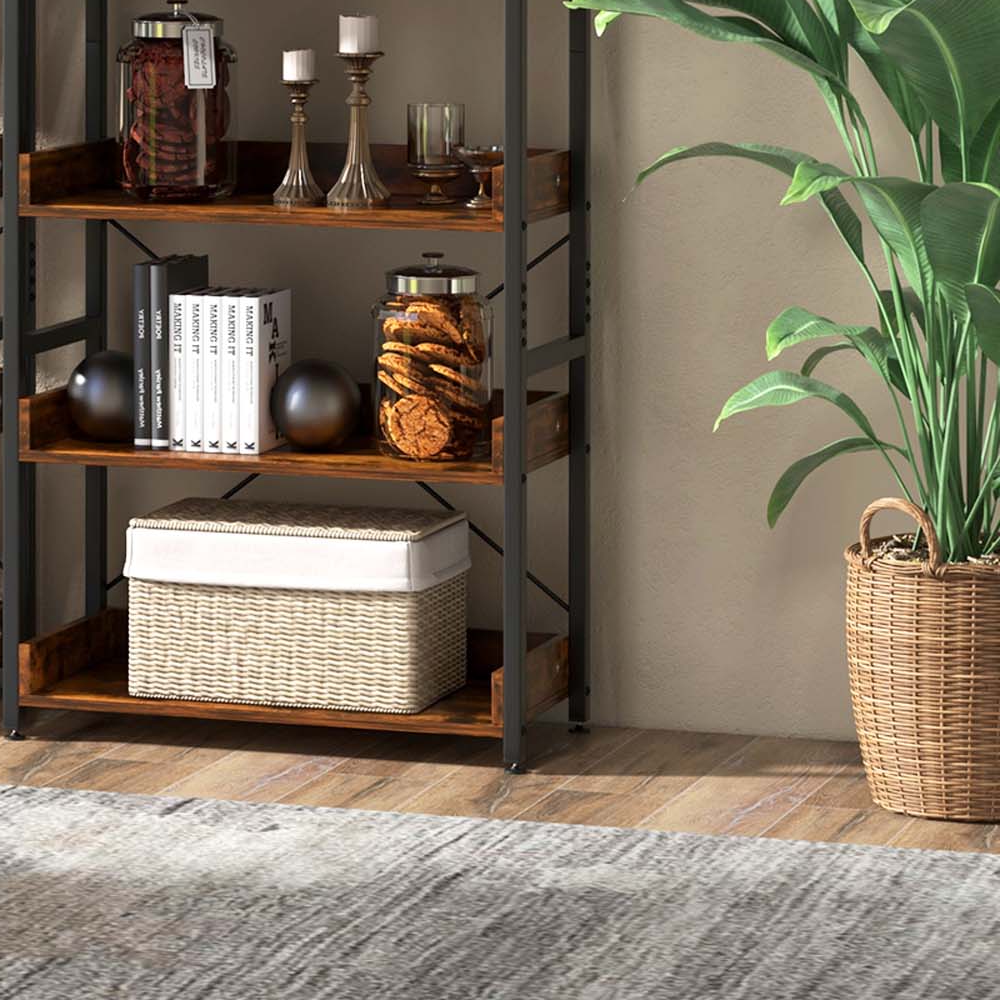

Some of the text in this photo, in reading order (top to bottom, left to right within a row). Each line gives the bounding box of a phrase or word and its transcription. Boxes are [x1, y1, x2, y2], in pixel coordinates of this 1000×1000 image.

[174, 303, 182, 341] MAKING
[174, 343, 182, 354] IT
[192, 344, 199, 354] IT
[210, 345, 217, 355] IT
[228, 346, 235, 356] IT
[246, 346, 253, 357] IT
